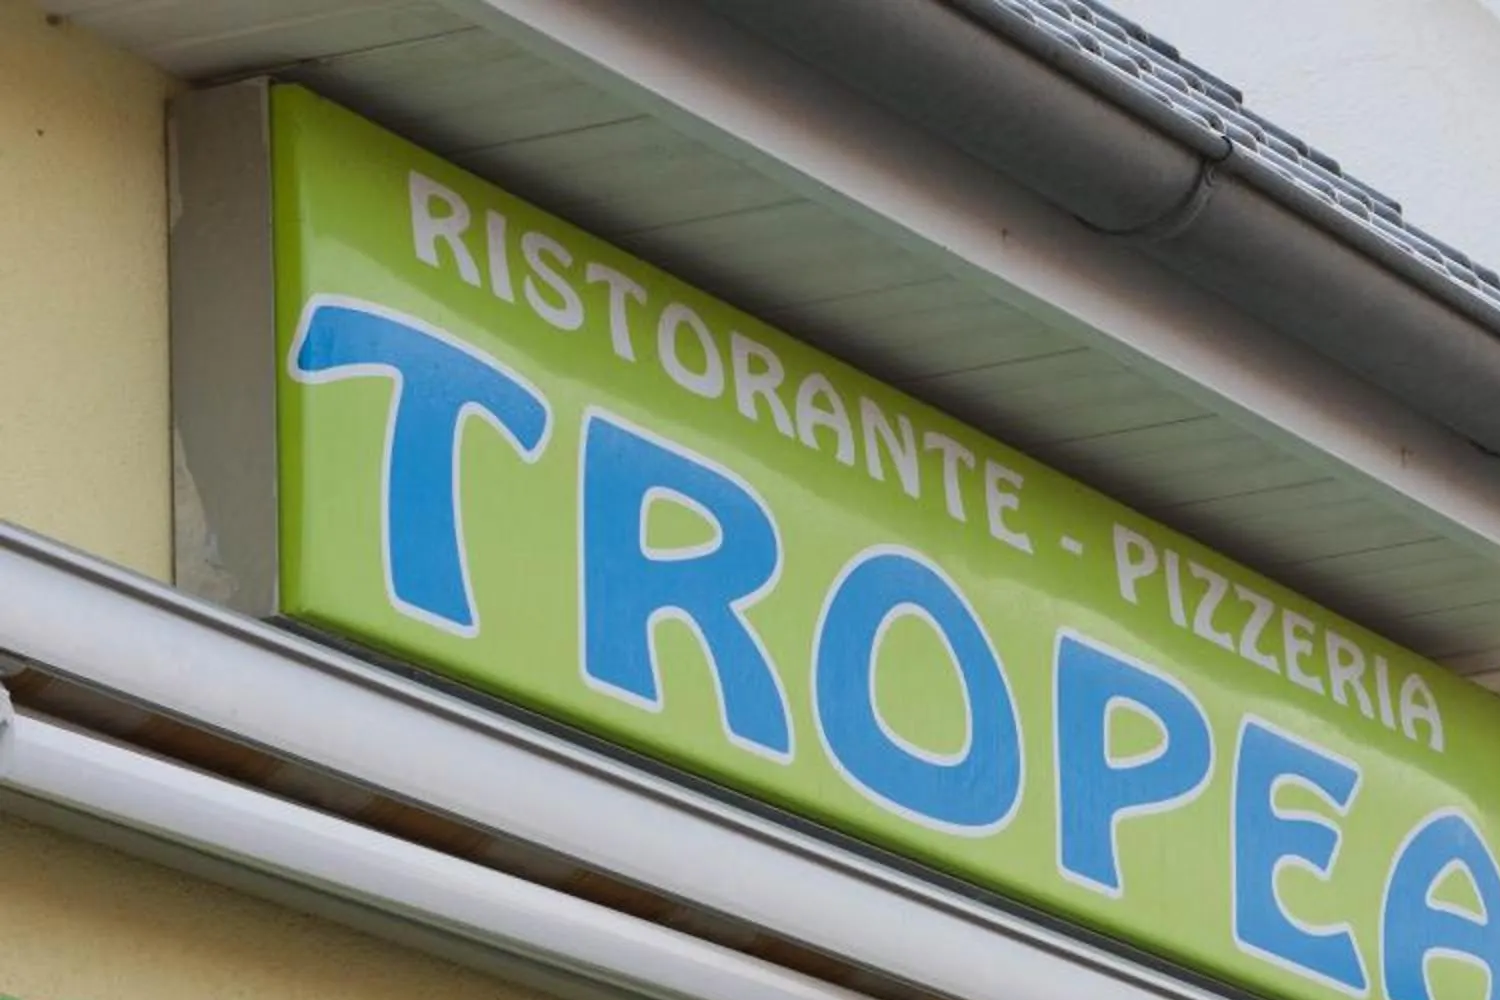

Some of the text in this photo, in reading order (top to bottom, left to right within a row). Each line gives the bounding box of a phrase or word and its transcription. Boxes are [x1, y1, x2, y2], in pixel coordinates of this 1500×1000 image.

[407, 169, 1444, 753] RISTORANTE - PIZZERIA
